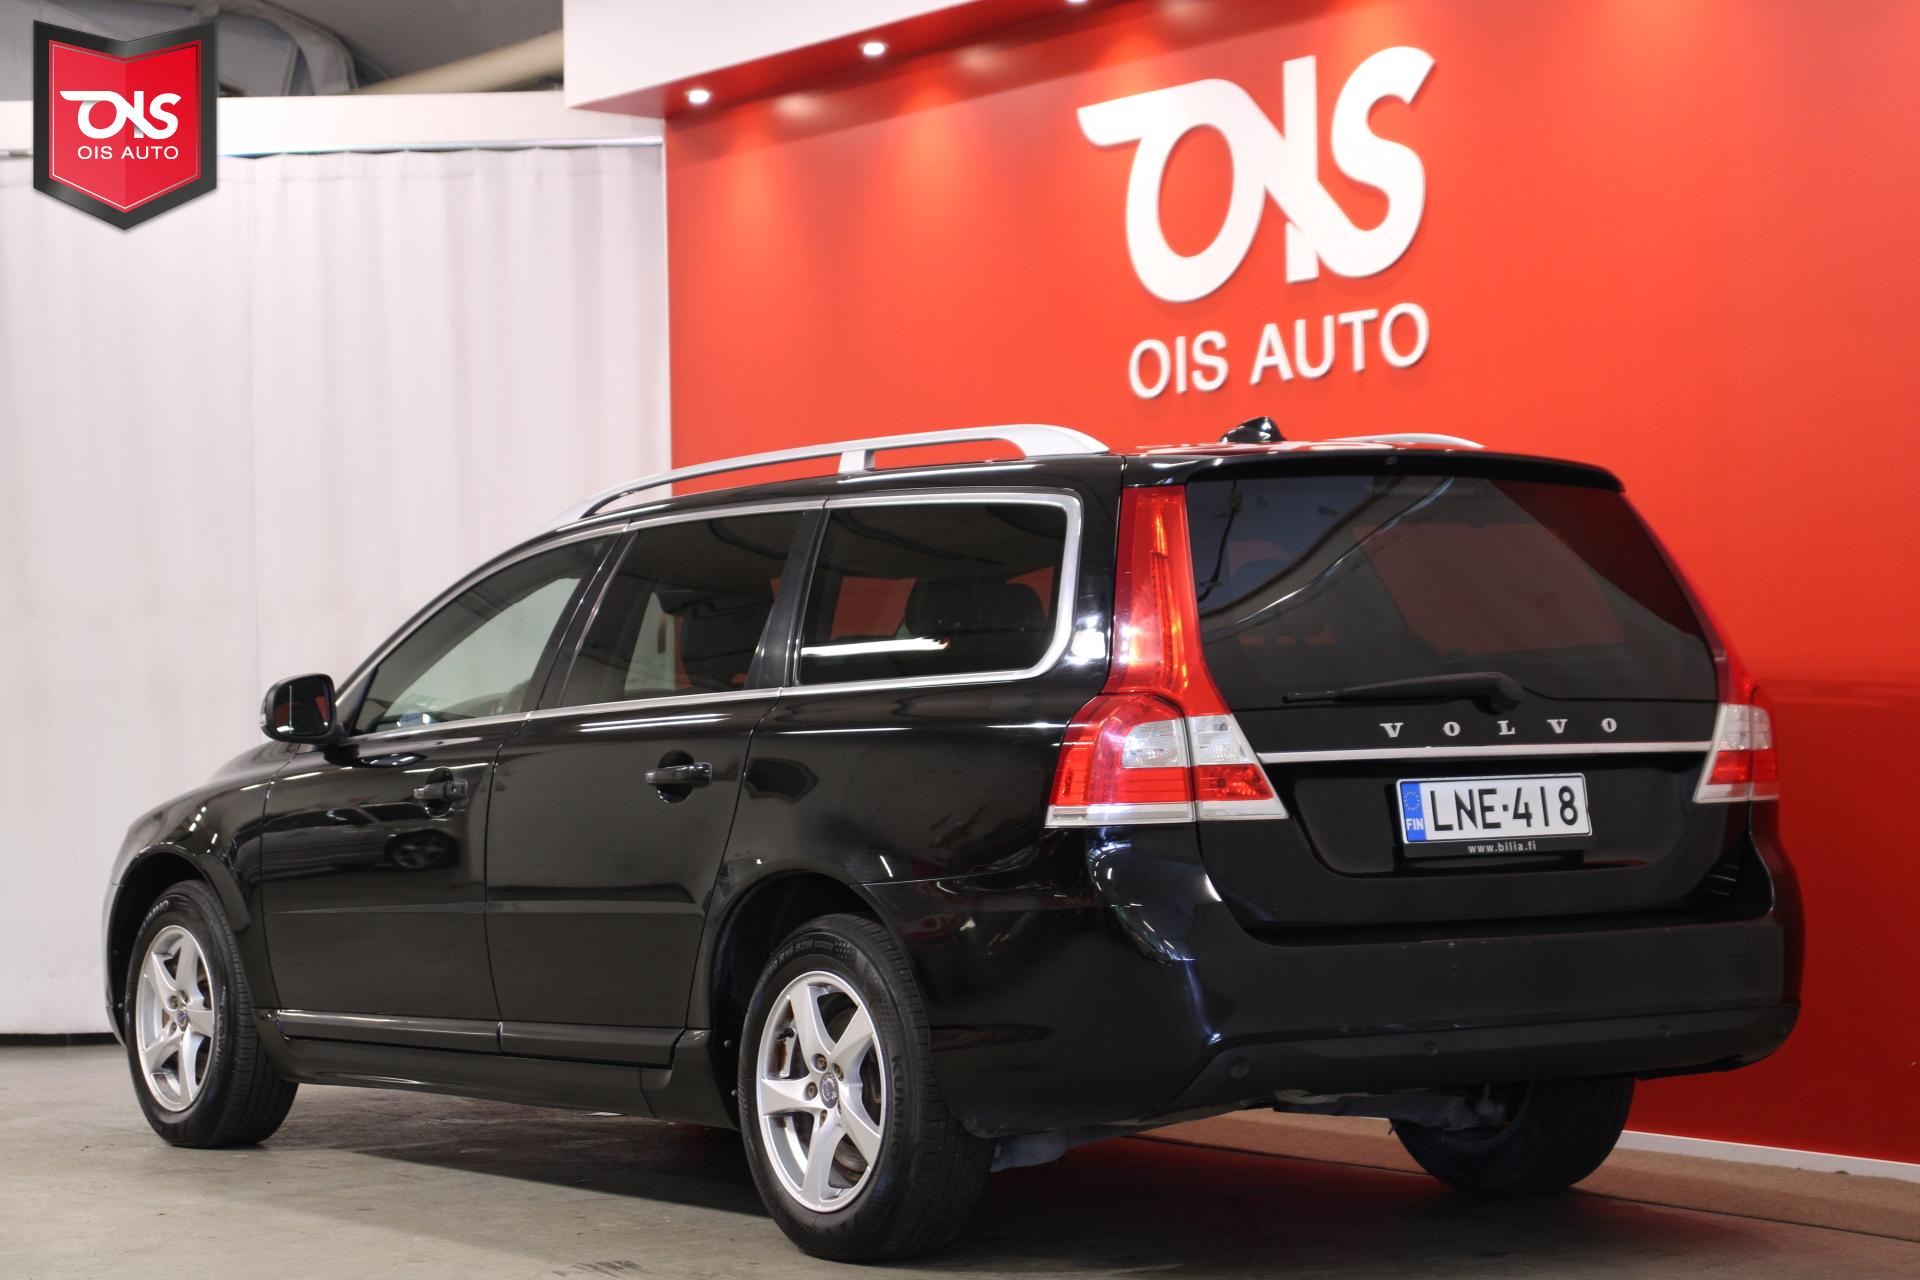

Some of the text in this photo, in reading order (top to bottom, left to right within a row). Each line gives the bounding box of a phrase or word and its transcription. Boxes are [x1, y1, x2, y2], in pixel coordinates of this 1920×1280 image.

[1077, 46, 1436, 303] OIS
[1128, 302, 1430, 400] OIS AUTO
[1379, 717, 1618, 738] VOLVO
[1405, 818, 1425, 831] FIN
[1467, 840, 1537, 854] www.bilia.fi
